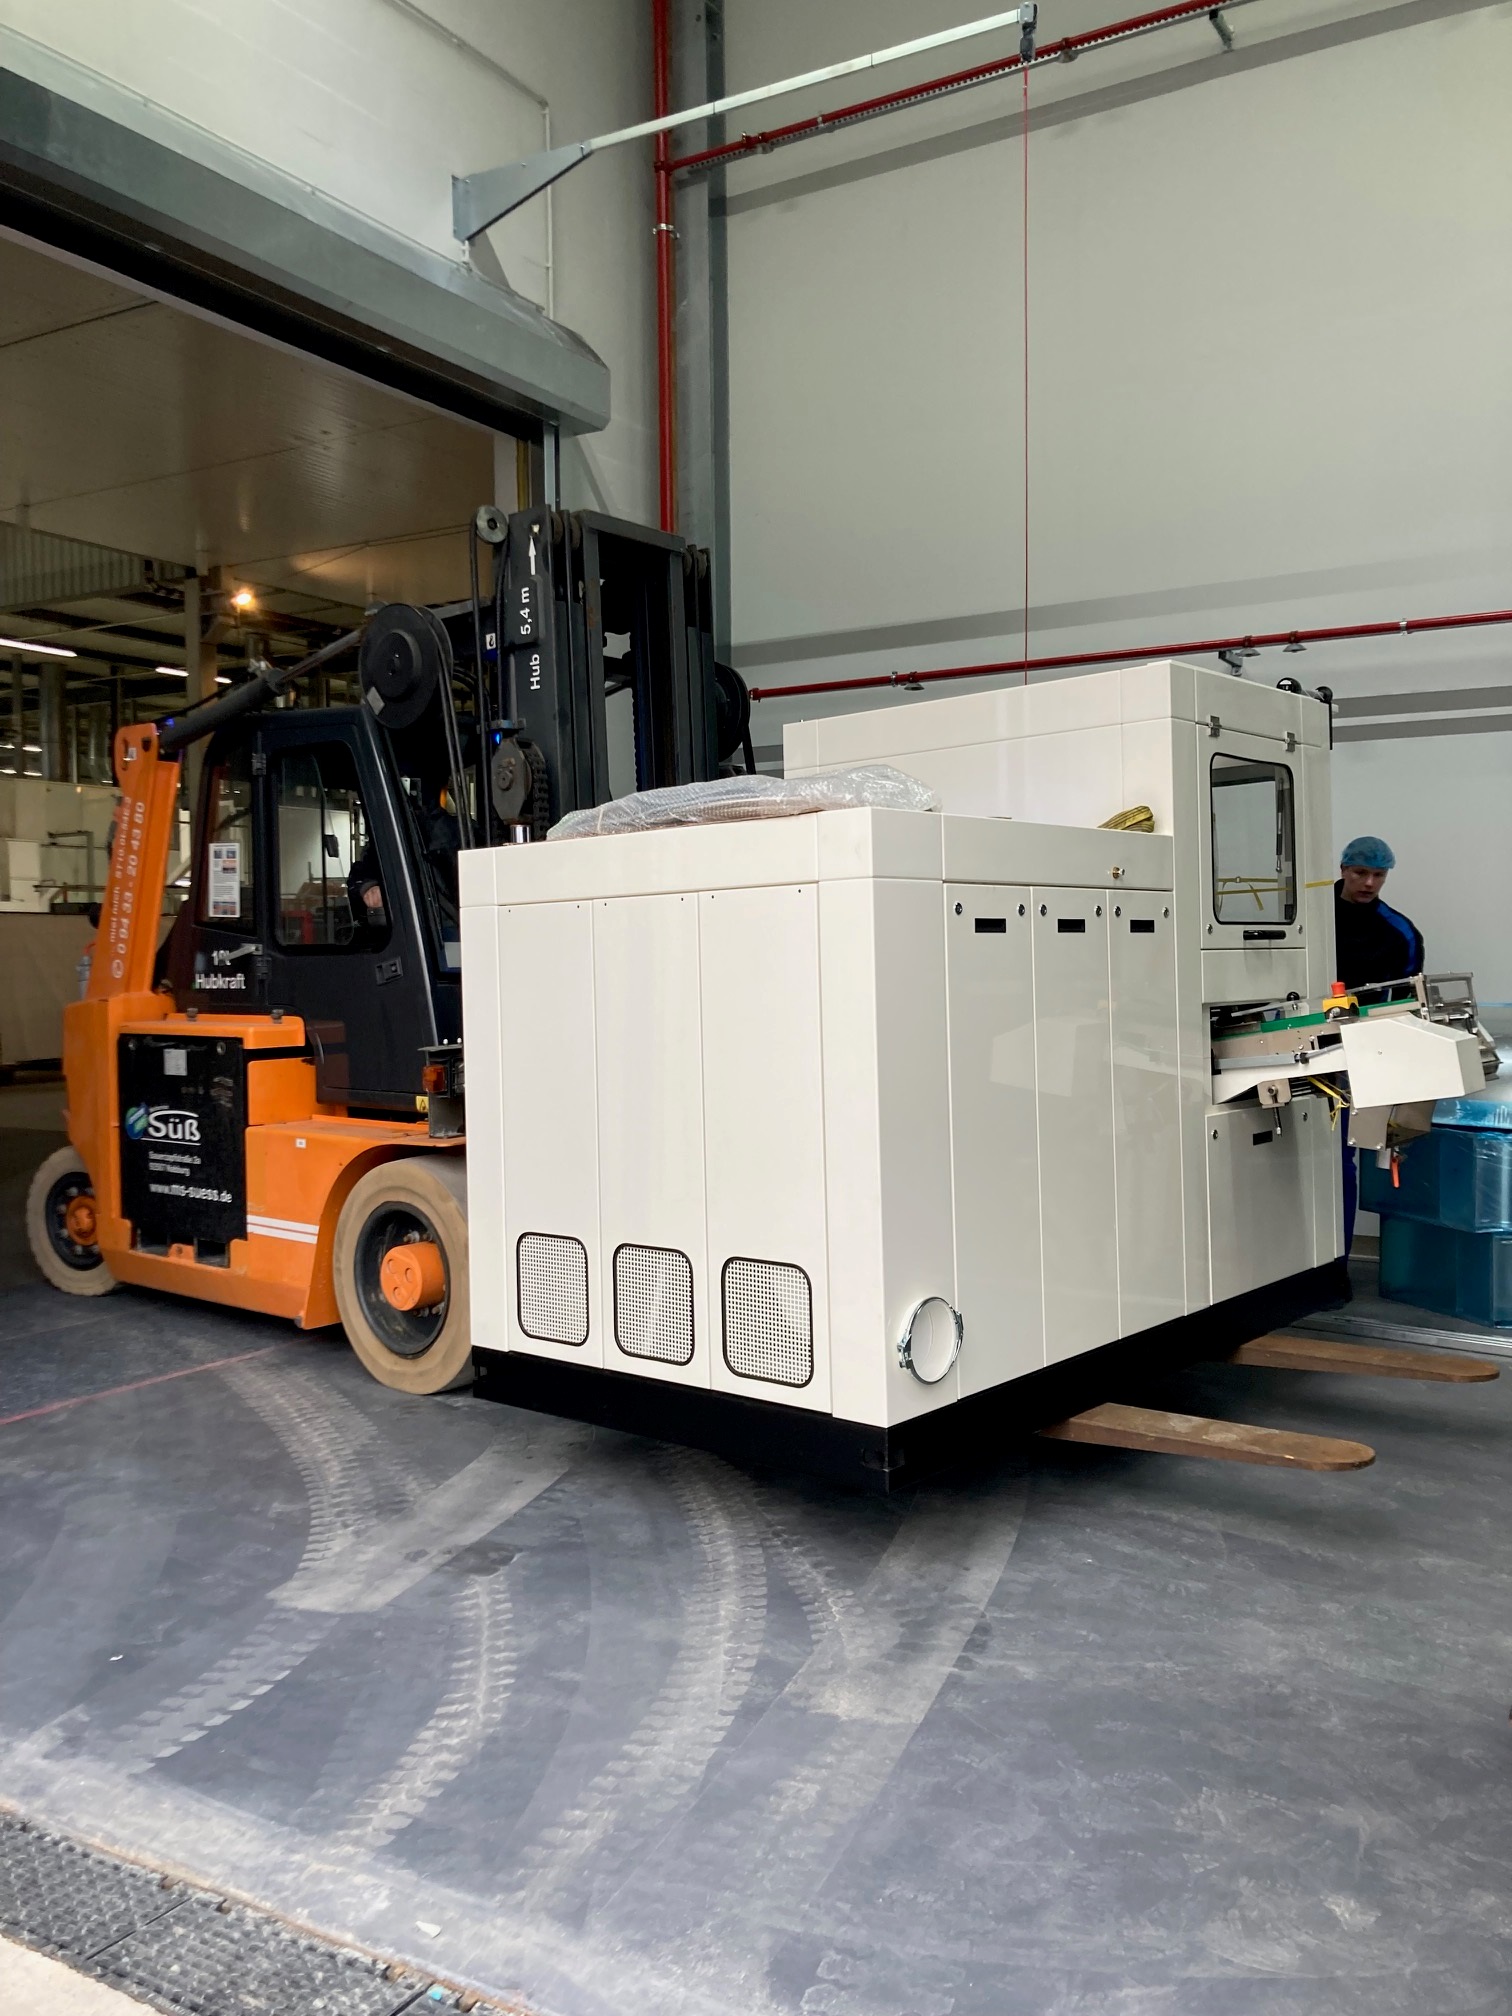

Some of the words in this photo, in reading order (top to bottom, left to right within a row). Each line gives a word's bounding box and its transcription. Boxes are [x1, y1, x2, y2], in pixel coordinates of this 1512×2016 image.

[521, 587, 530, 603] m
[520, 607, 532, 635] 5,4
[530, 654, 540, 690] Hub
[133, 802, 145, 824] 80
[131, 828, 142, 850] 43
[126, 854, 138, 877] 20
[195, 973, 246, 989] Hubkraft
[148, 1110, 201, 1141] Süß
